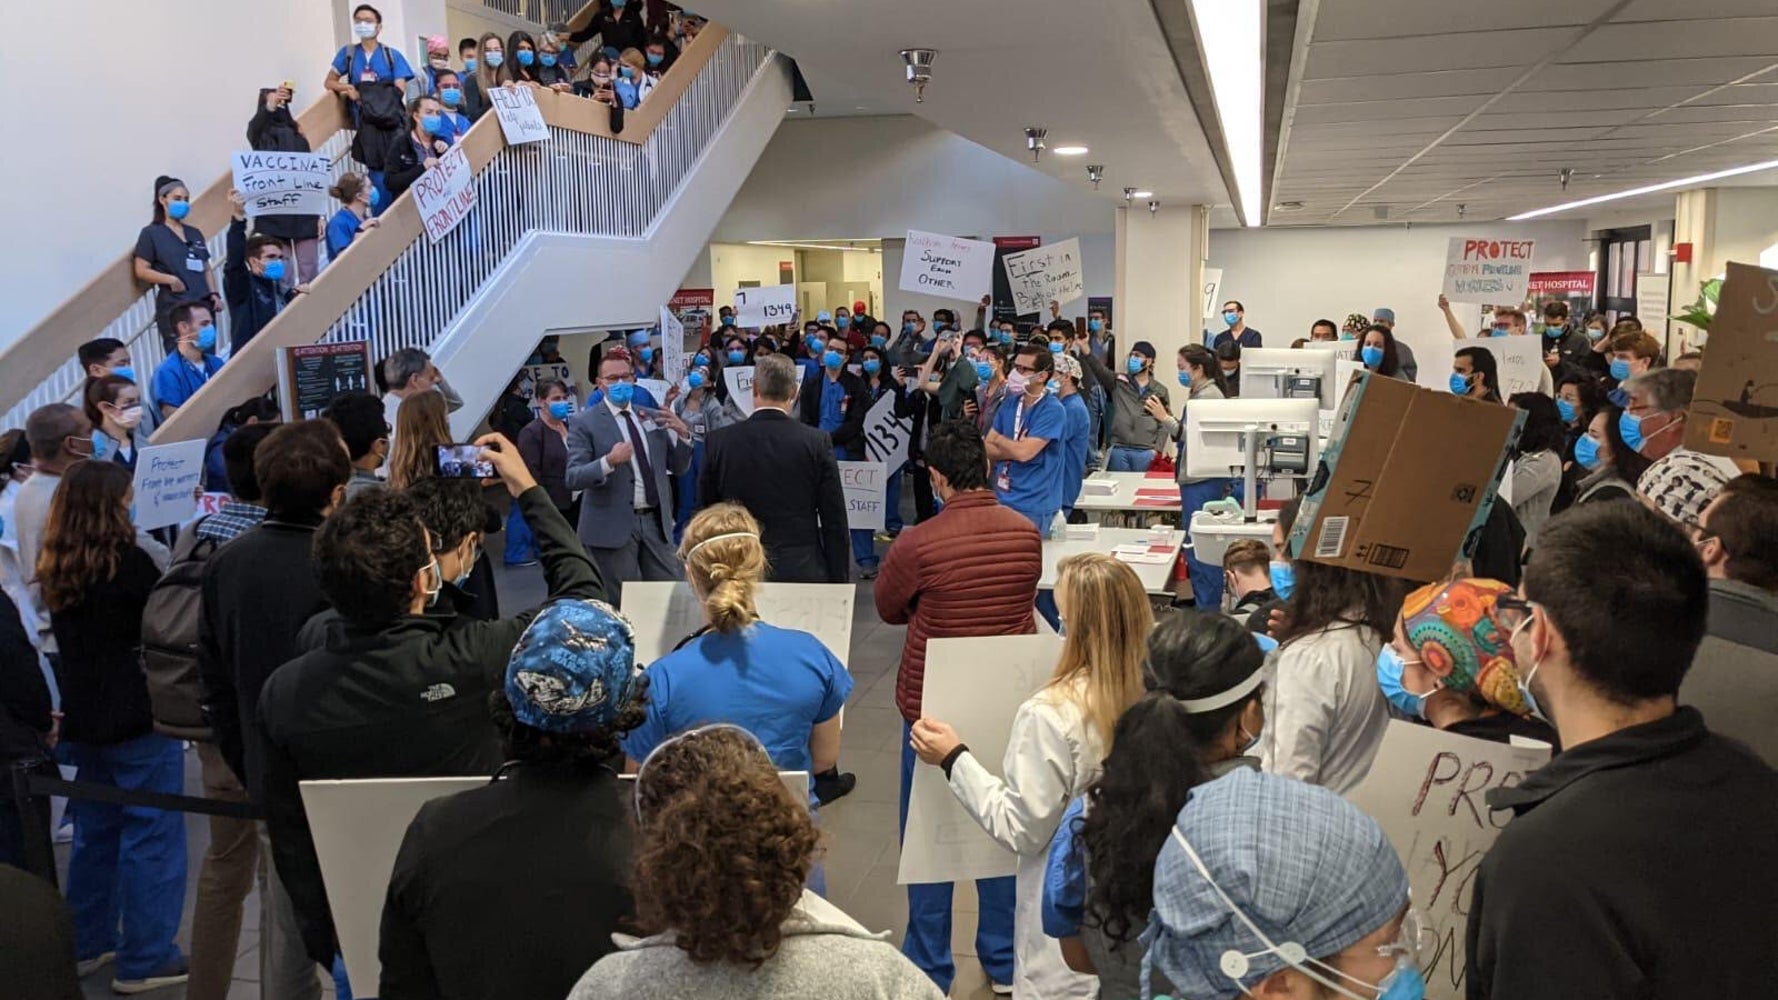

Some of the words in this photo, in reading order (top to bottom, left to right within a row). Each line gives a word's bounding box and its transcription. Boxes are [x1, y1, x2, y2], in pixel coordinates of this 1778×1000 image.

[240, 155, 333, 171] VACCINATE
[416, 148, 464, 209] PROTECT
[1464, 240, 1534, 260] PROTECT
[1545, 280, 1589, 289] HOSPITAL
[763, 303, 793, 318] 1349
[551, 366, 569, 379] TO
[848, 499, 880, 513] STAFF
